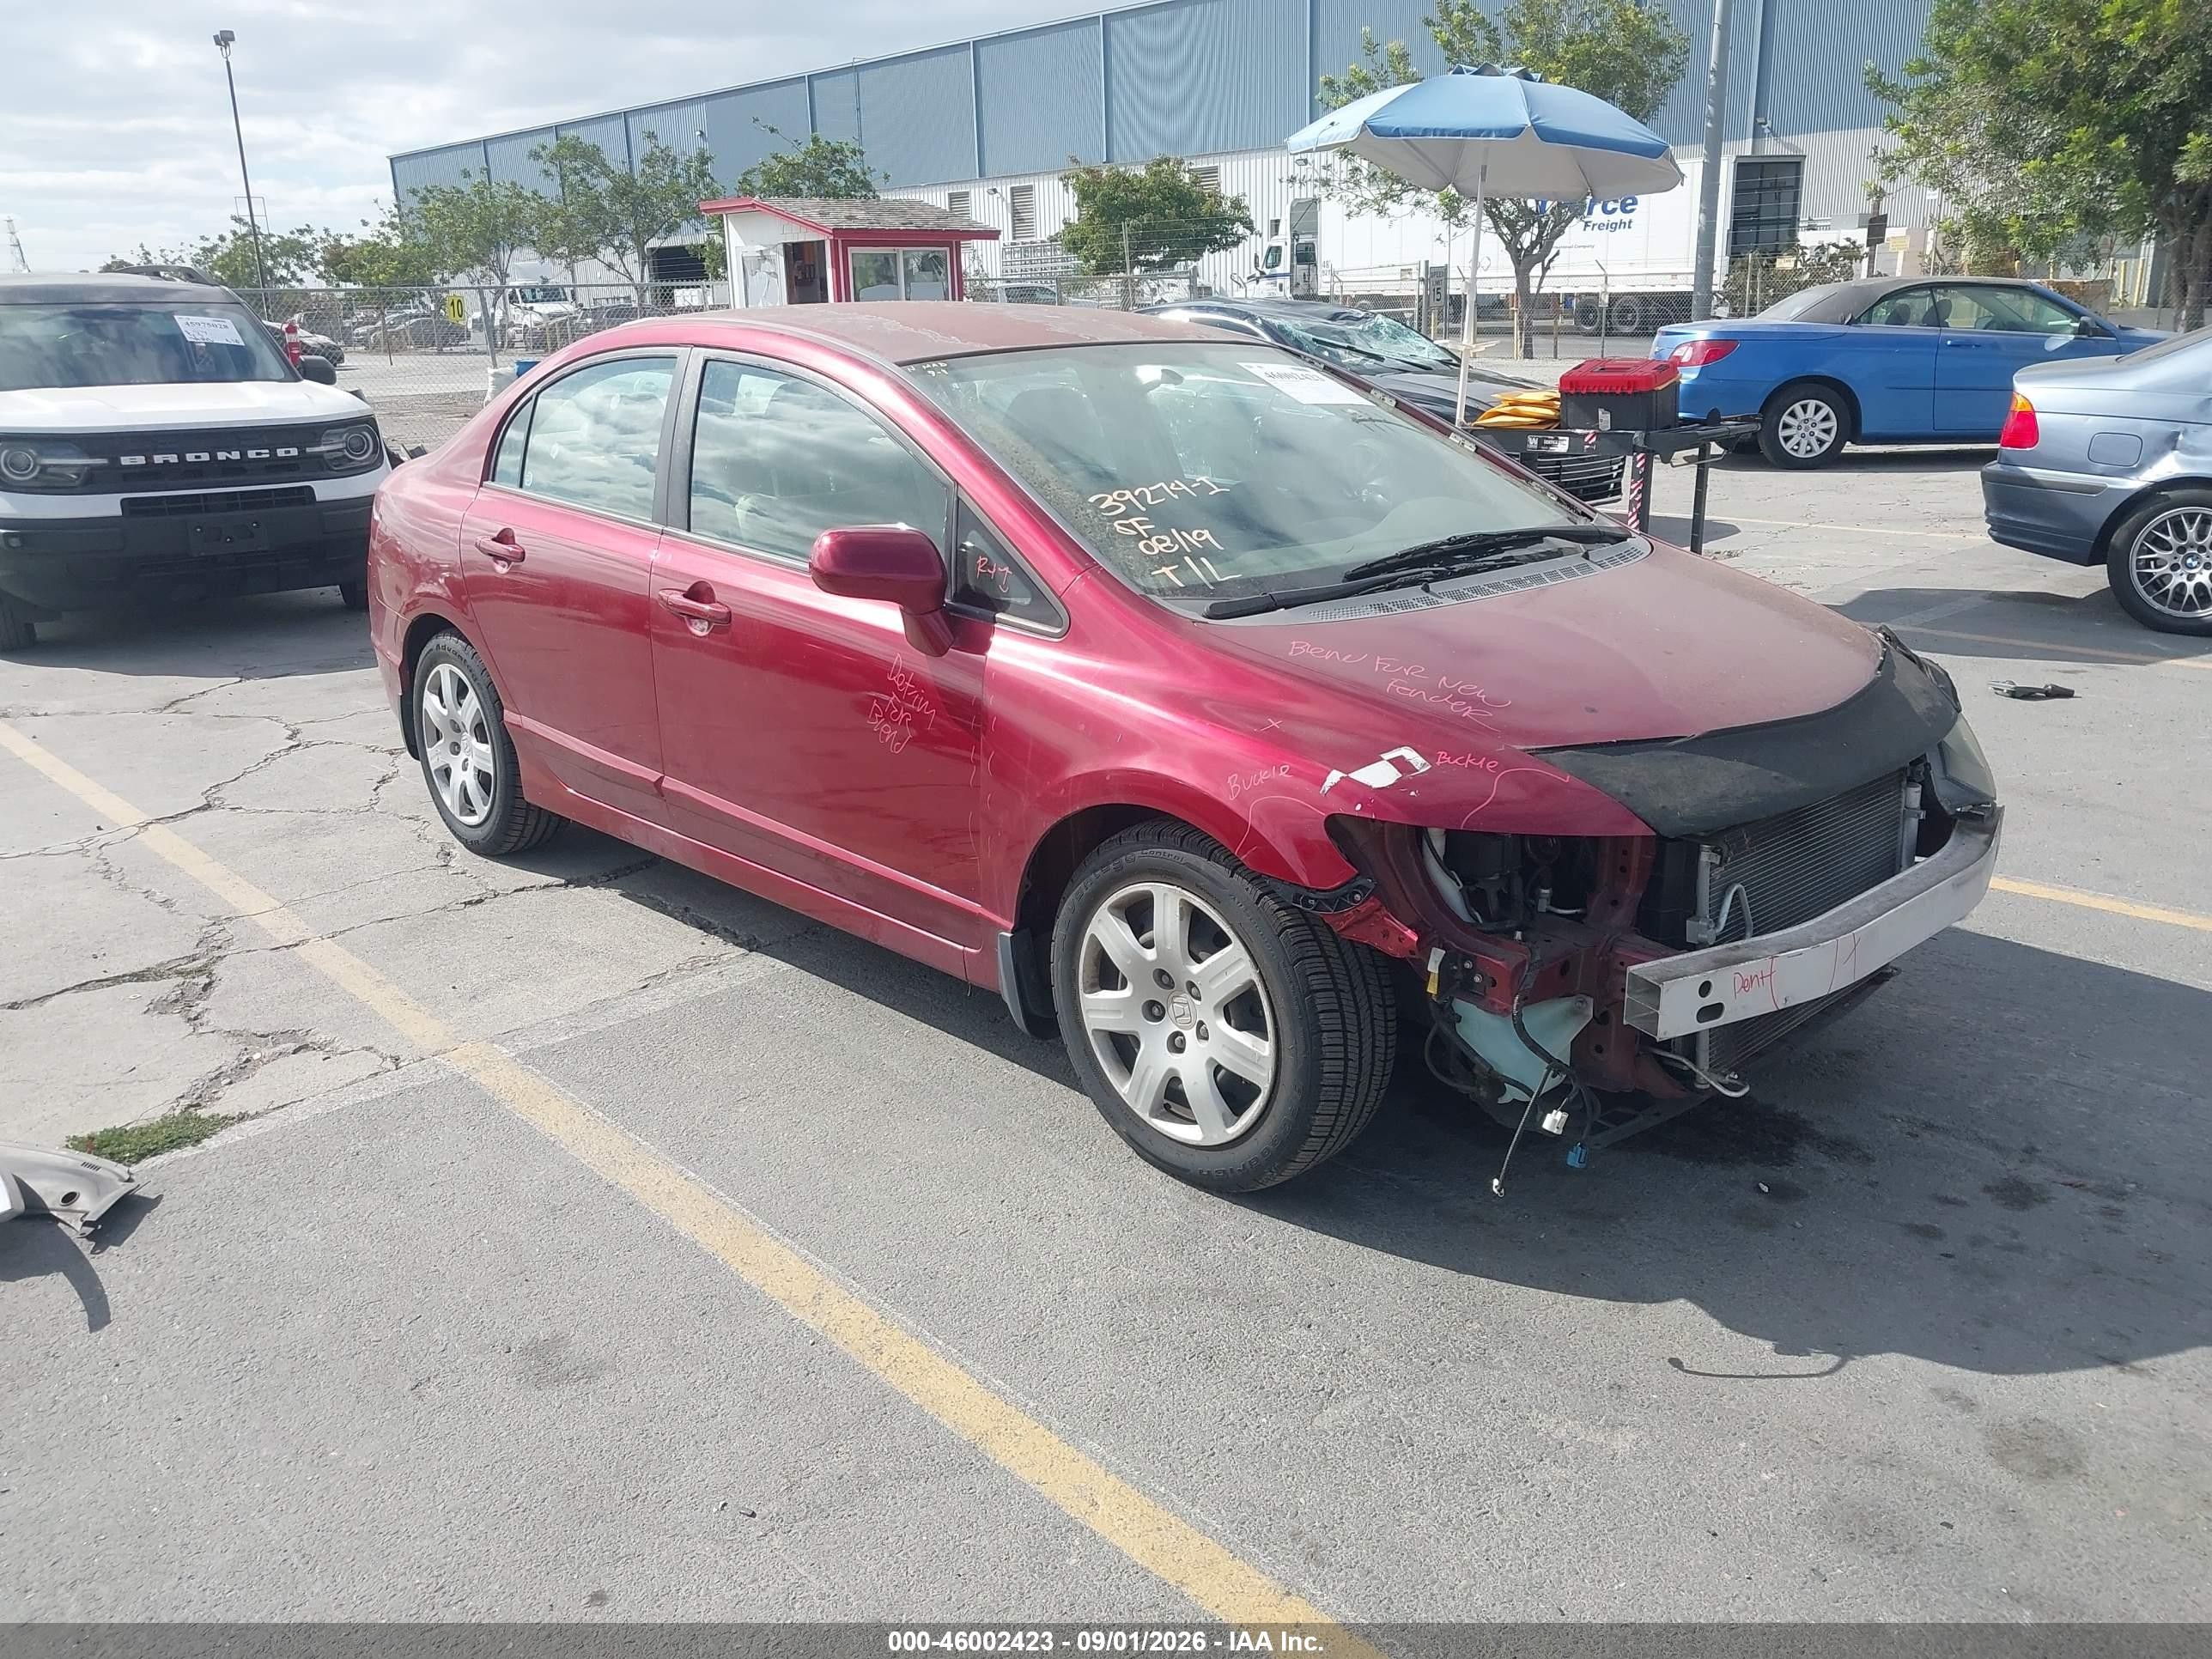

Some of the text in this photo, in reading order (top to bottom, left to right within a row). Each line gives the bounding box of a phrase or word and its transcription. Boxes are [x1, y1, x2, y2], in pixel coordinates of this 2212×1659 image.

[1583, 219, 1633, 233] Freight
[1432, 287, 1442, 302] 15
[450, 299, 464, 318] 10
[120, 447, 299, 465] BRONCO
[1138, 528, 1224, 556] 08/19
[1141, 848, 1186, 863] Control
